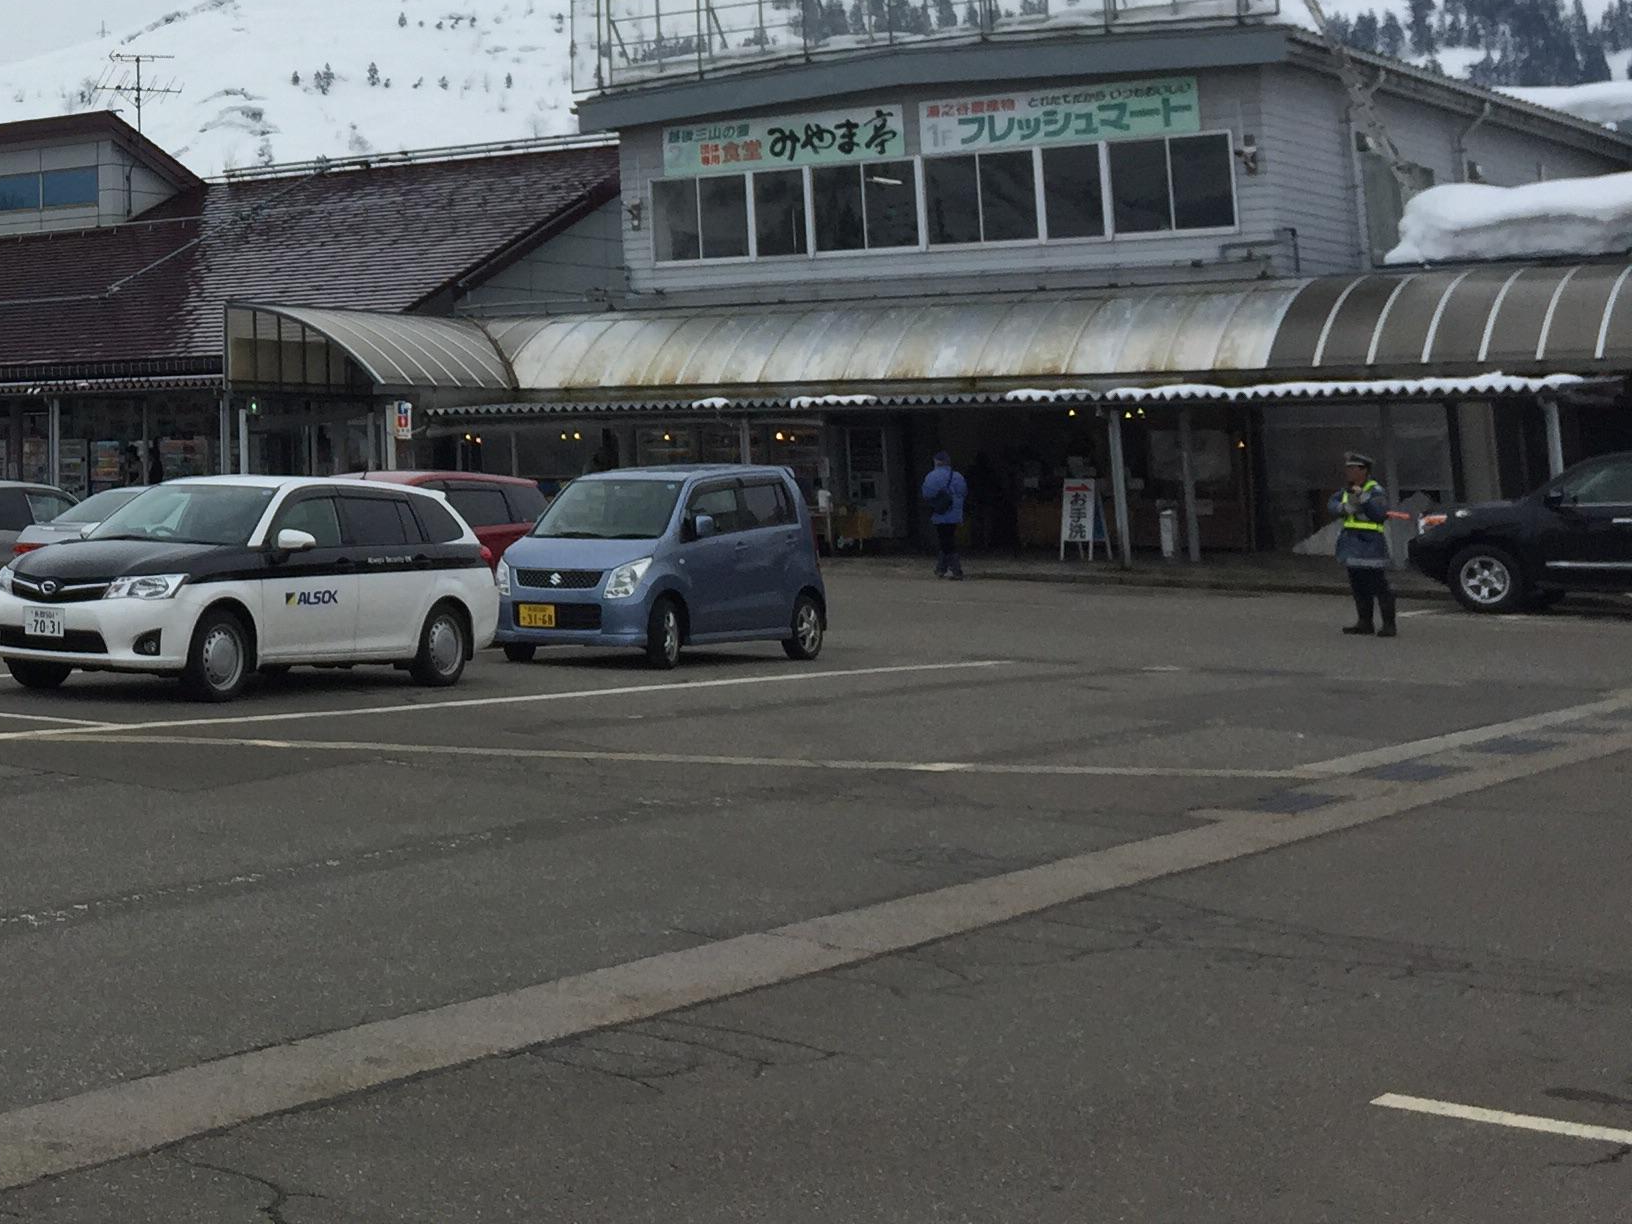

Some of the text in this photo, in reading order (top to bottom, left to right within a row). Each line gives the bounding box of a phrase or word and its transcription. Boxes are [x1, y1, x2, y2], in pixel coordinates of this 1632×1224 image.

[768, 110, 896, 161] みやま亭
[958, 97, 1192, 144] フレッシュマート
[722, 139, 763, 163] 食堂
[1070, 492, 1087, 539] お手洗
[297, 589, 338, 605] ALSOK
